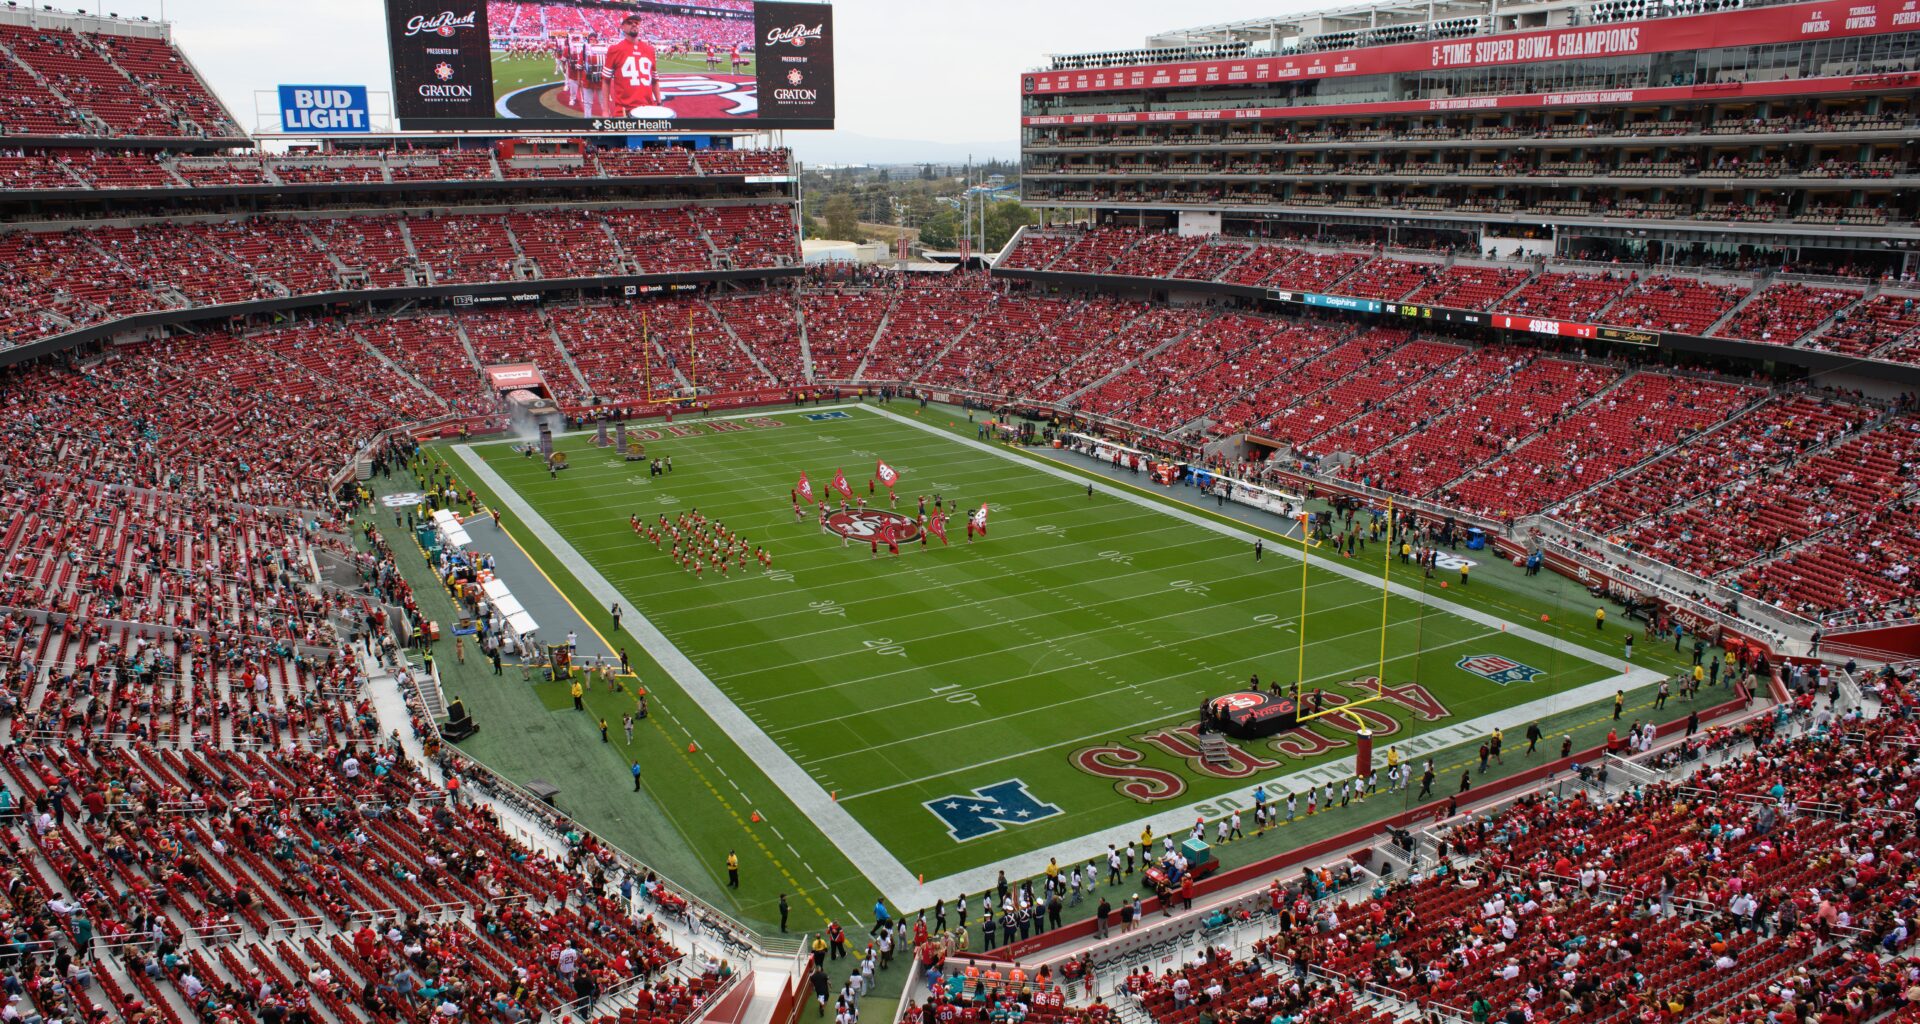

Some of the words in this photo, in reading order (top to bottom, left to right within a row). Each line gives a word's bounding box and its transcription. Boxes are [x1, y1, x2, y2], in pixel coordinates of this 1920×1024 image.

[1849, 6, 1876, 16] TERRELL
[1802, 20, 1830, 34] OWENS
[1845, 16, 1877, 30] OWENS
[1432, 43, 1471, 66] 5-TIME
[1475, 39, 1515, 63] SUPER
[1517, 36, 1553, 59] BOWL
[1557, 27, 1639, 56] CHAMPIONS
[621, 56, 653, 86] 49
[419, 84, 472, 97] GRATON
[774, 88, 817, 100] GRATON
[1600, 92, 1633, 102] CHAMPIONS
[295, 90, 352, 109] BUD
[1470, 98, 1498, 108] CHAMPIONS
[285, 109, 364, 128] LIGHT
[604, 120, 636, 130] Sutter
[638, 119, 672, 129] Health
[512, 293, 539, 301] verizon
[1326, 297, 1357, 307] Dolphins
[1386, 304, 1396, 313] PRE
[1528, 319, 1559, 335] 49ERS
[1169, 579, 1211, 595] 20
[808, 599, 845, 615] 30
[1253, 613, 1297, 630] 10
[862, 637, 905, 655] 20
[929, 683, 977, 703] 10
[1293, 762, 1354, 785] ALL
[1194, 797, 1243, 818] US
[941, 1011, 953, 1020] 80
